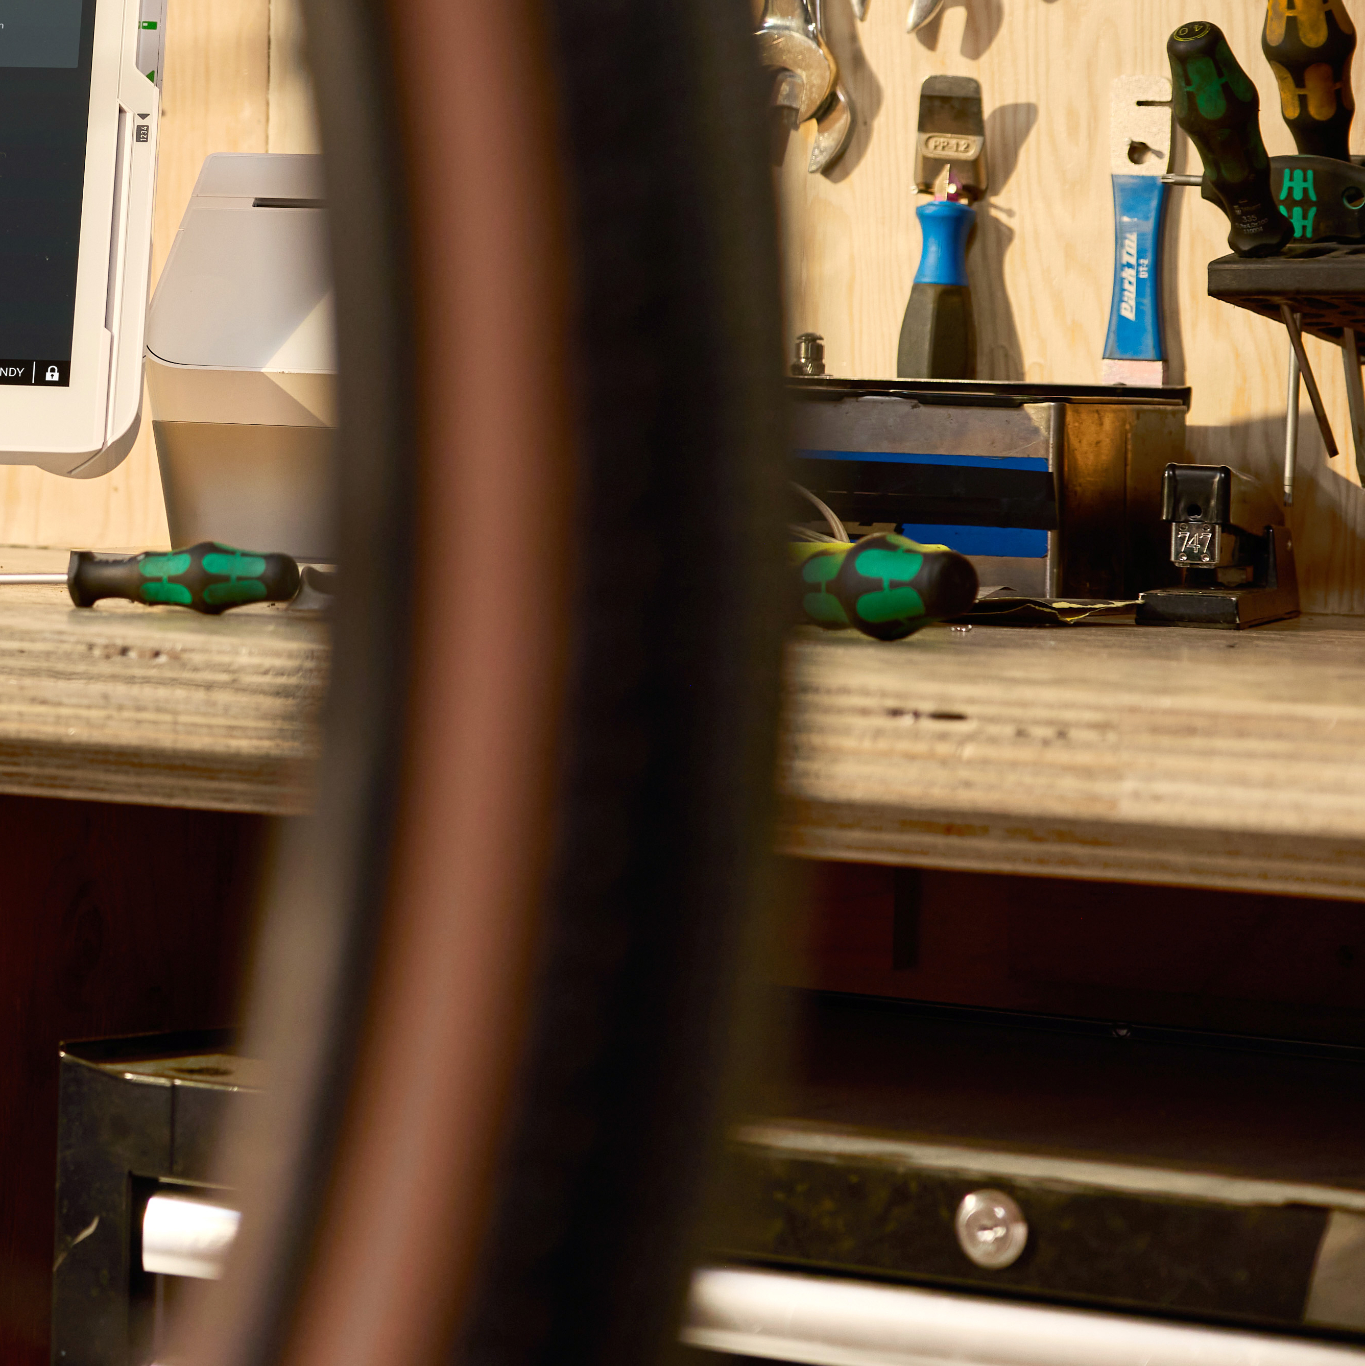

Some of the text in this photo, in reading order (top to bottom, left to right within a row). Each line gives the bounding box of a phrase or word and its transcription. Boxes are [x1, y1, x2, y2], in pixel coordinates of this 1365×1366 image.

[932, 138, 970, 154] PP-1.2
[1120, 215, 1137, 321] Park To
[1177, 531, 1212, 554] 747
